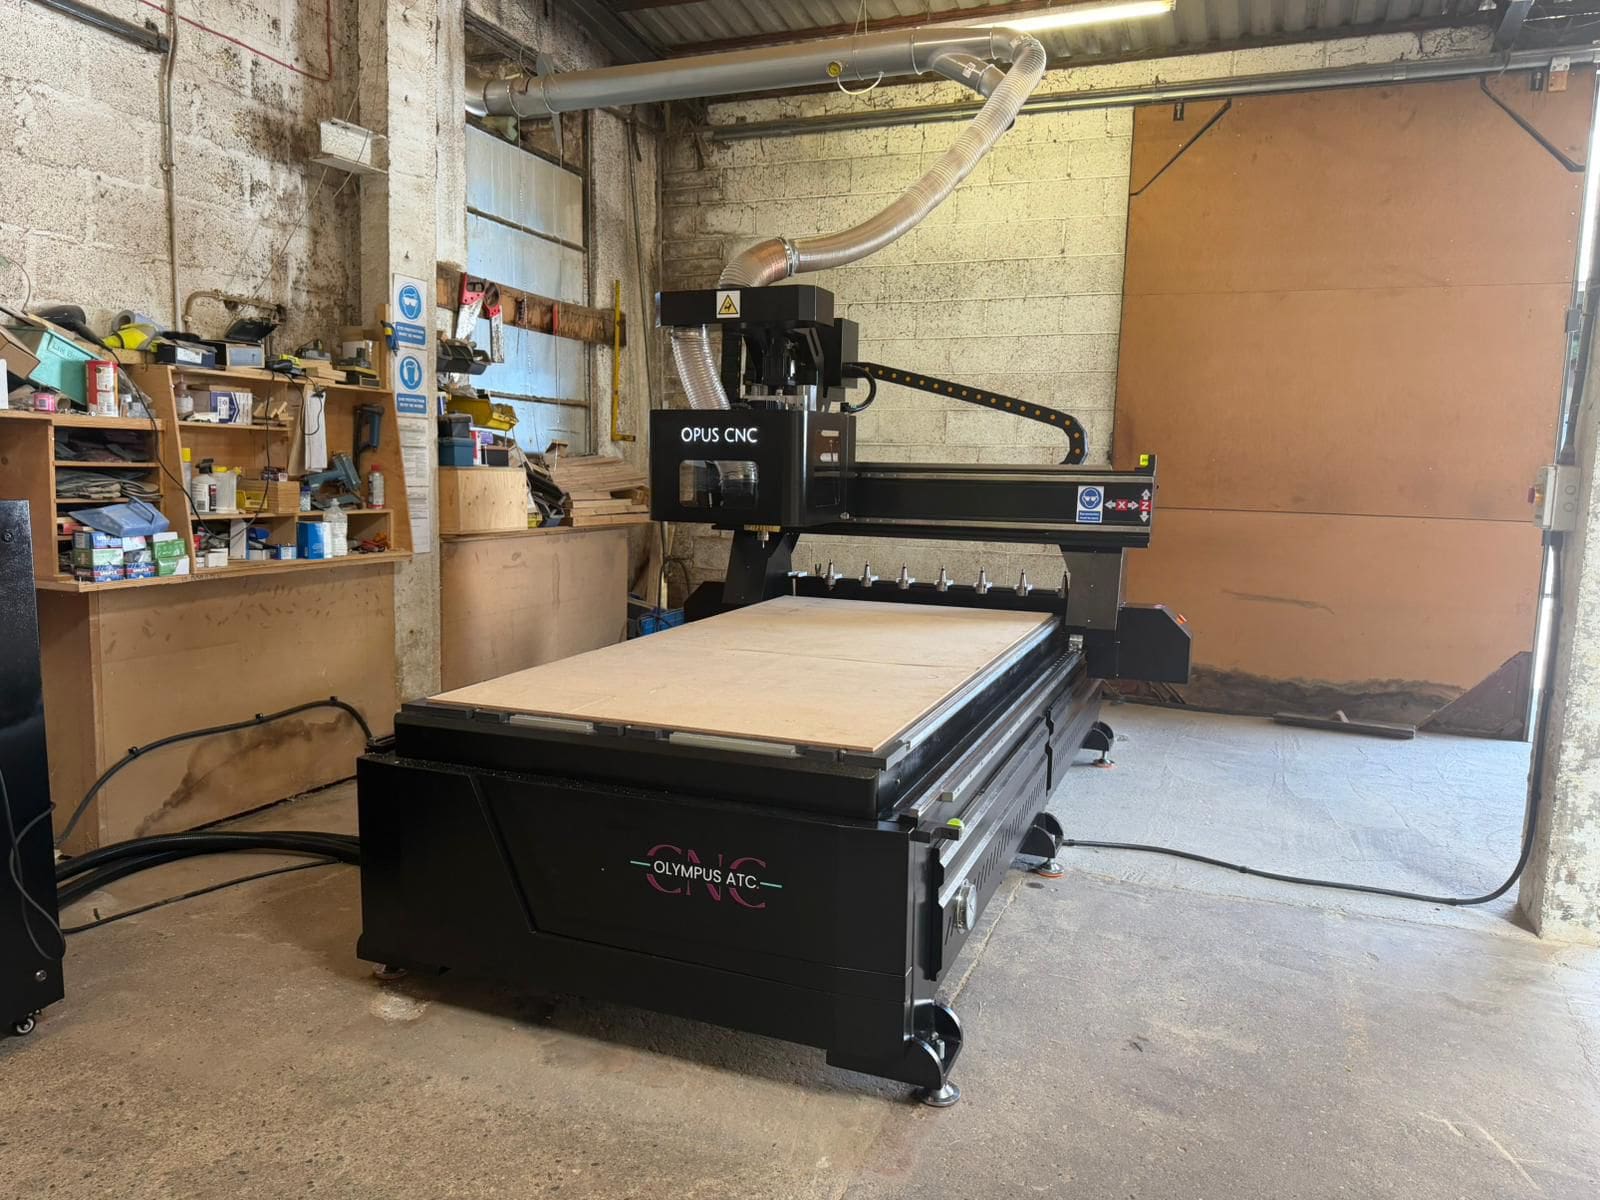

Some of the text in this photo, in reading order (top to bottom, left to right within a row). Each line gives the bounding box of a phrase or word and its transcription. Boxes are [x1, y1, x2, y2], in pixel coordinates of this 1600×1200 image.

[681, 427, 758, 443] OPUS CNC
[1118, 501, 1126, 509] X
[1141, 501, 1149, 510] Z
[647, 844, 767, 908] CNC
[653, 860, 722, 883] OLYMPUS
